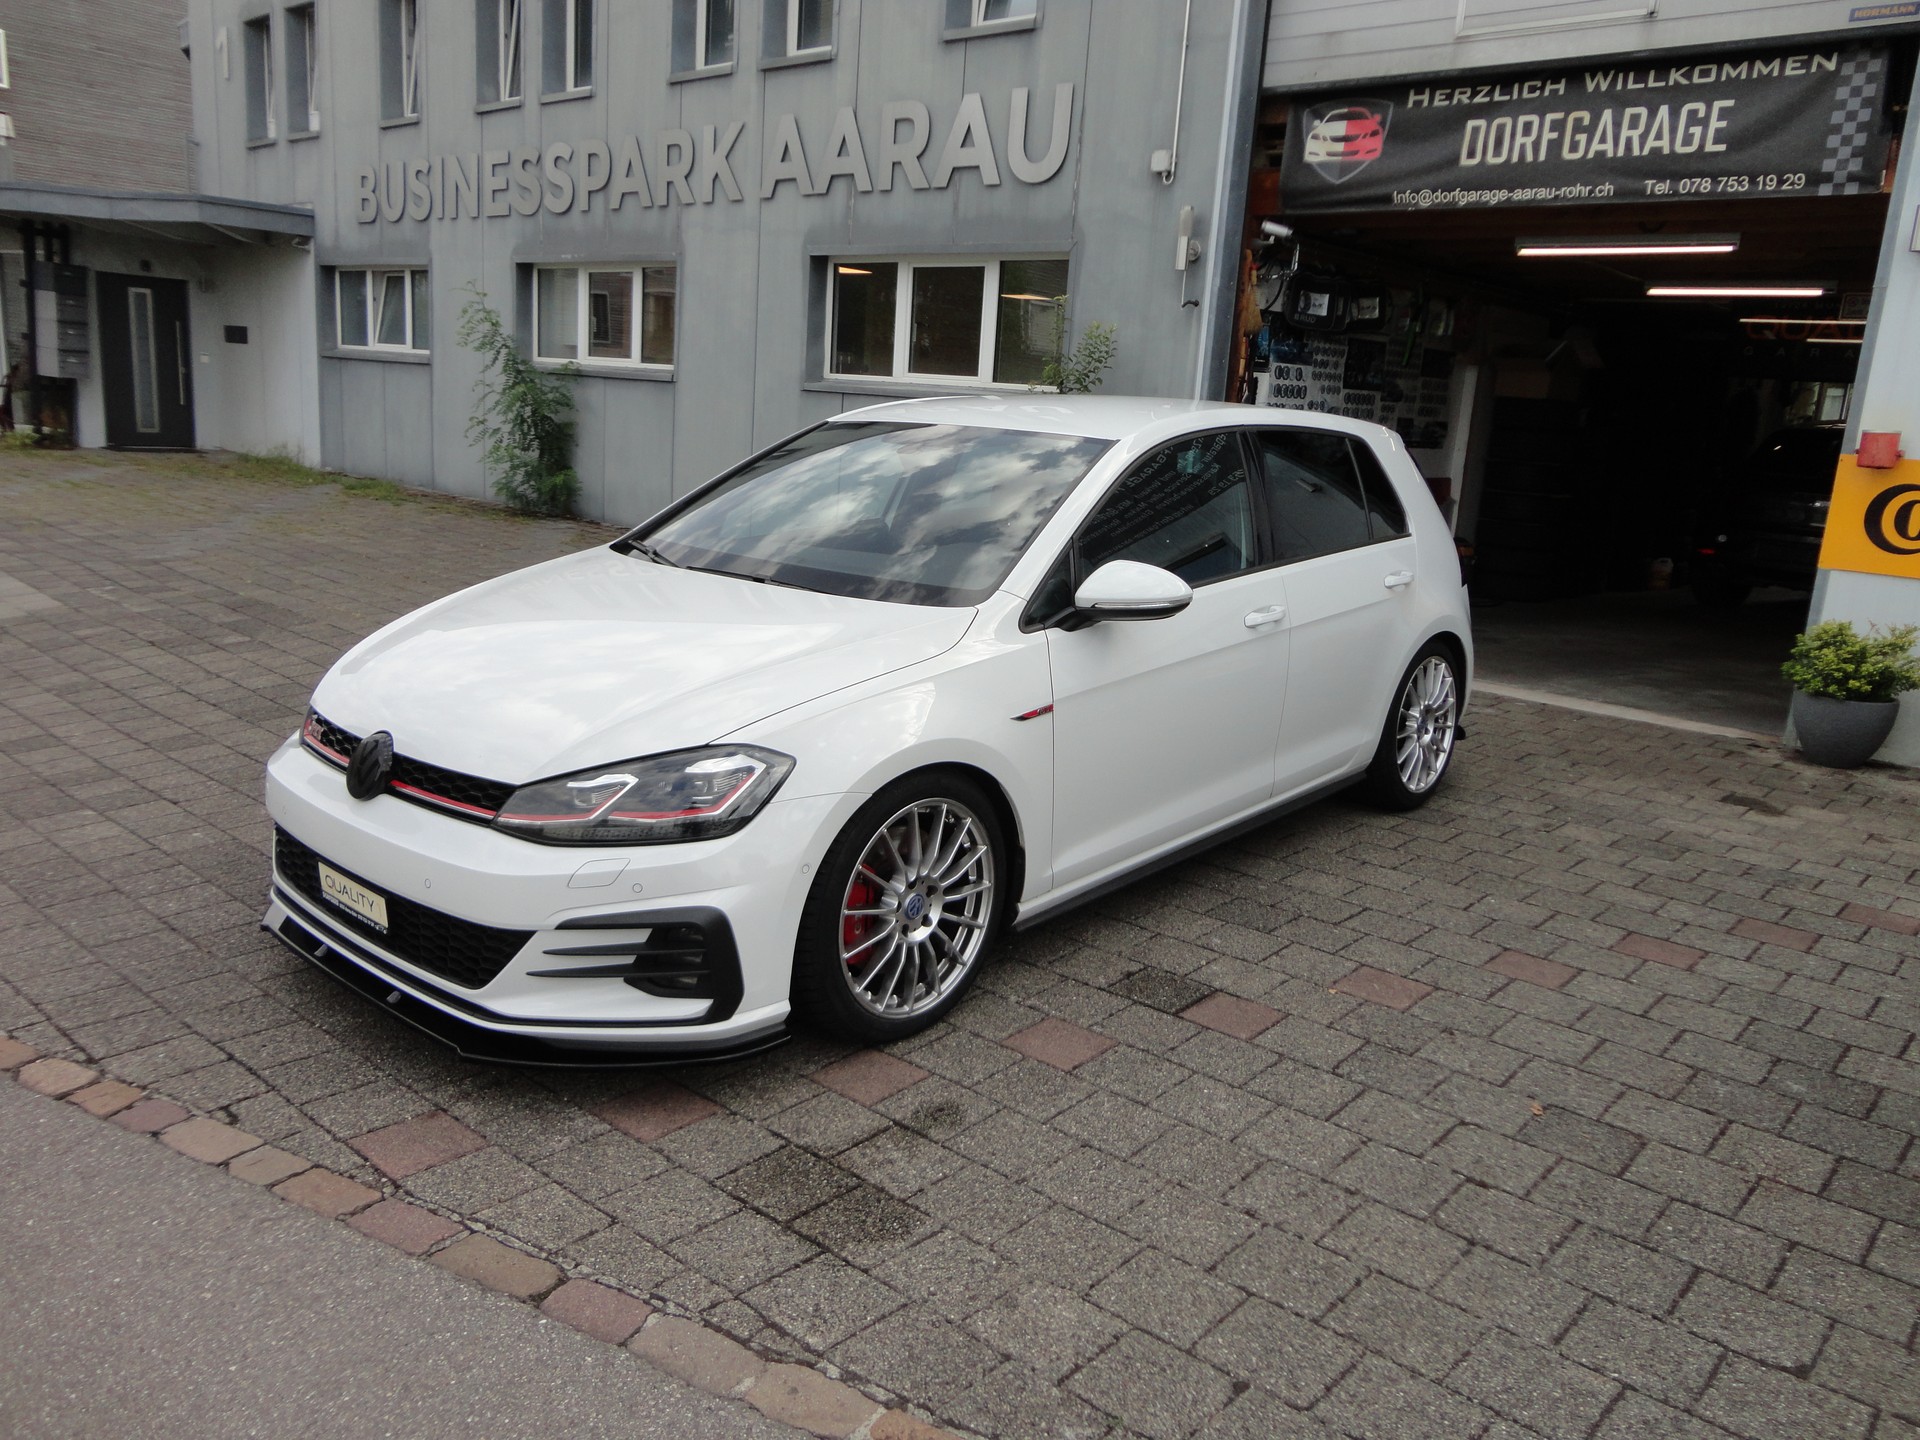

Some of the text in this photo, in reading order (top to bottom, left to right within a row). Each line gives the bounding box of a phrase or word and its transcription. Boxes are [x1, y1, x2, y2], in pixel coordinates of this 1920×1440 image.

[1407, 52, 1839, 108] HERZLICH WILLKOMMEN
[356, 82, 1075, 224] BUSINESSPARK AARAU
[1458, 99, 1735, 167] DORFGARAGE
[1393, 183, 1615, 206] Info@dorfgarage-aarau-rohr.ch
[1644, 173, 1806, 195] Tel. 078 753 19 29
[324, 874, 374, 912] QUALITY
